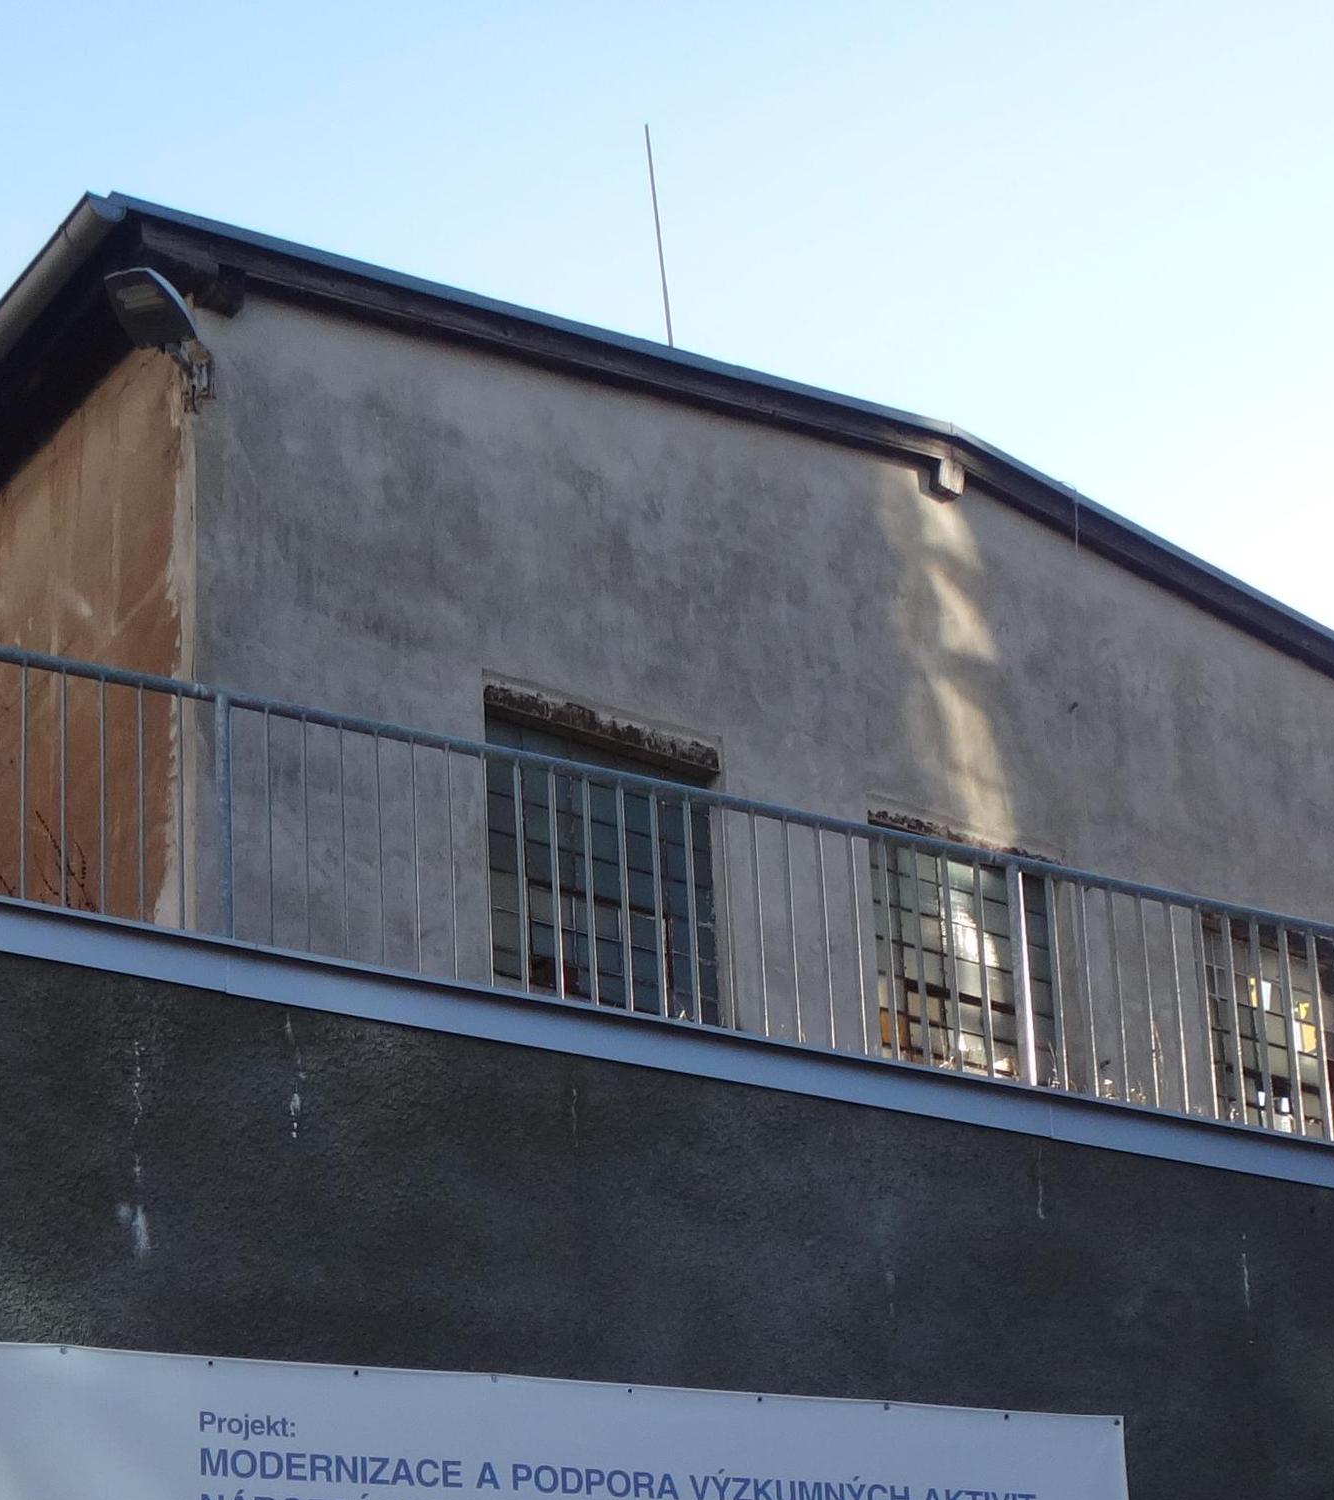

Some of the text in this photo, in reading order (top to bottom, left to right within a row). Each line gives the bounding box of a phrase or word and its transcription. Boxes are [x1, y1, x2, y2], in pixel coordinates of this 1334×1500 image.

[199, 1410, 296, 1442] Projekt:
[199, 1446, 464, 1489] MODERNIZACE
[475, 1461, 502, 1491] A
[511, 1463, 681, 1500] PODPORA
